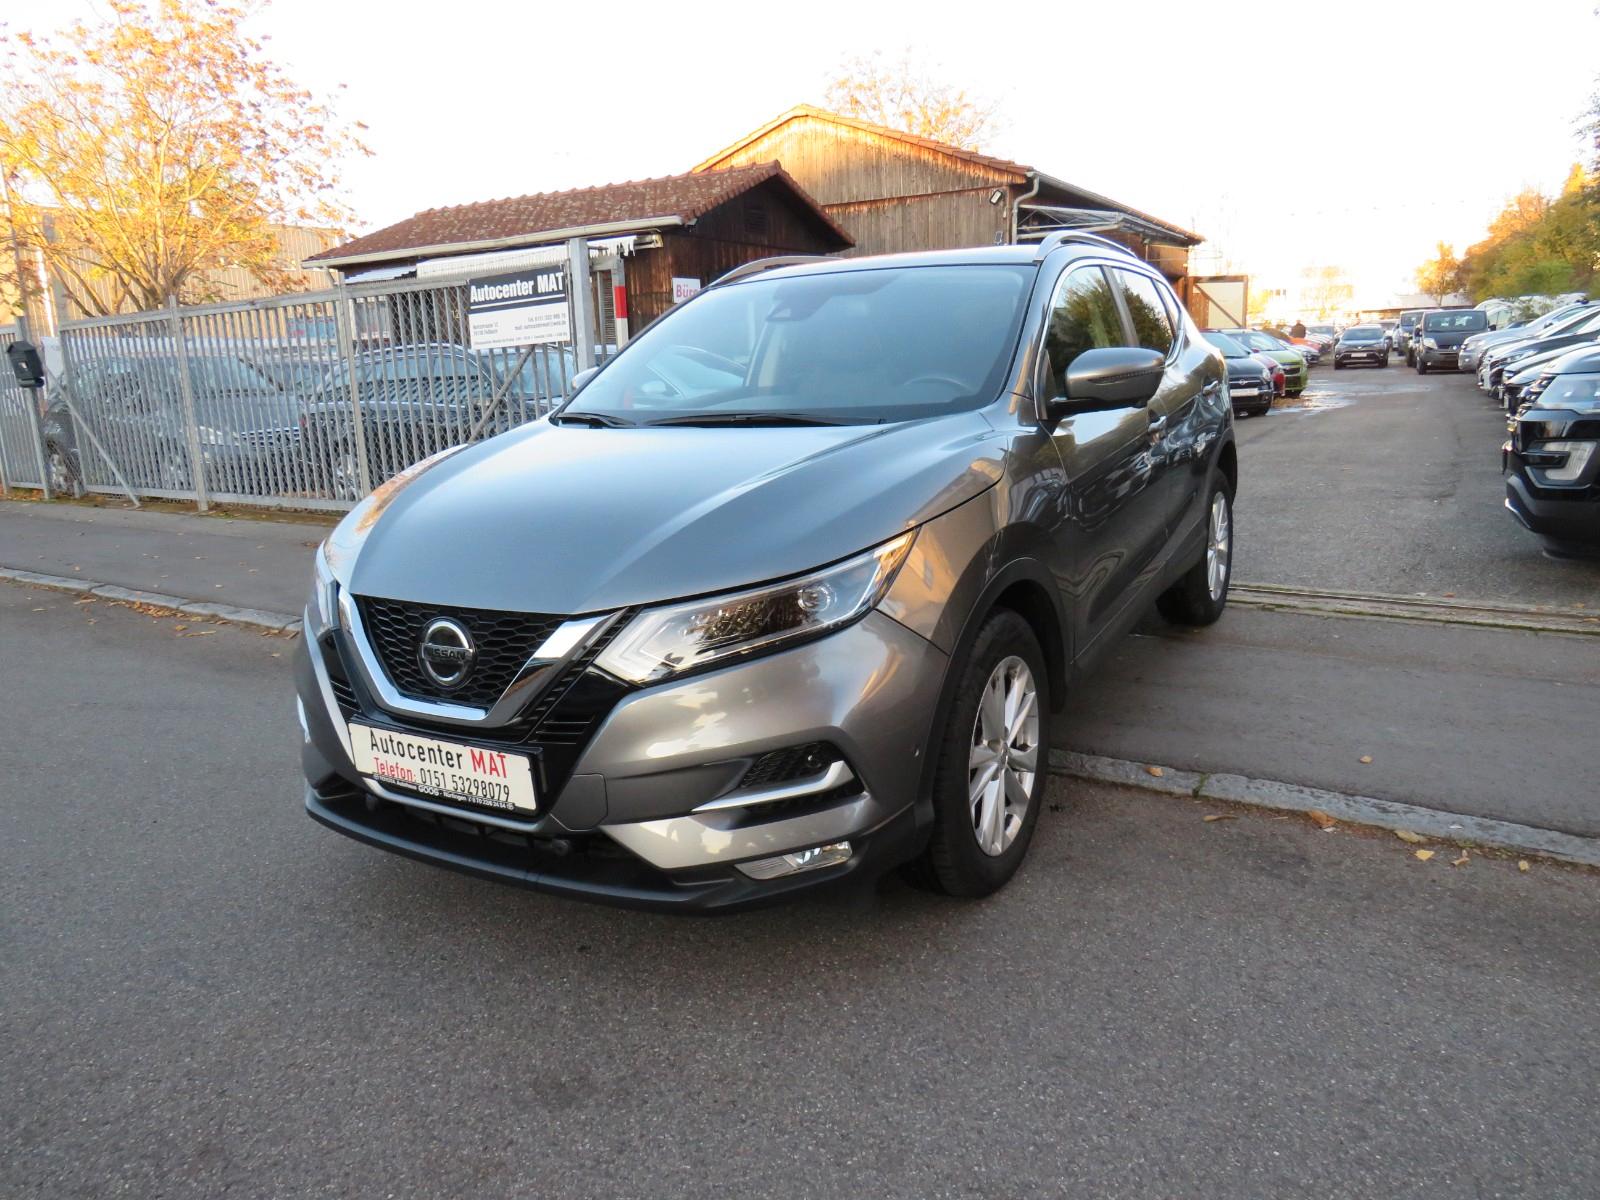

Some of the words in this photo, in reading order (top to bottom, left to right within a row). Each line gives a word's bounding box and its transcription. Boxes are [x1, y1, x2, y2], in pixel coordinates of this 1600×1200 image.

[470, 279, 534, 303] Autocenter
[537, 271, 564, 293] MAT
[370, 729, 463, 770] Autocenter
[470, 748, 509, 778] MAT
[373, 757, 416, 783] Telefon:
[420, 768, 447, 788] 0151
[452, 775, 511, 802] 53298079
